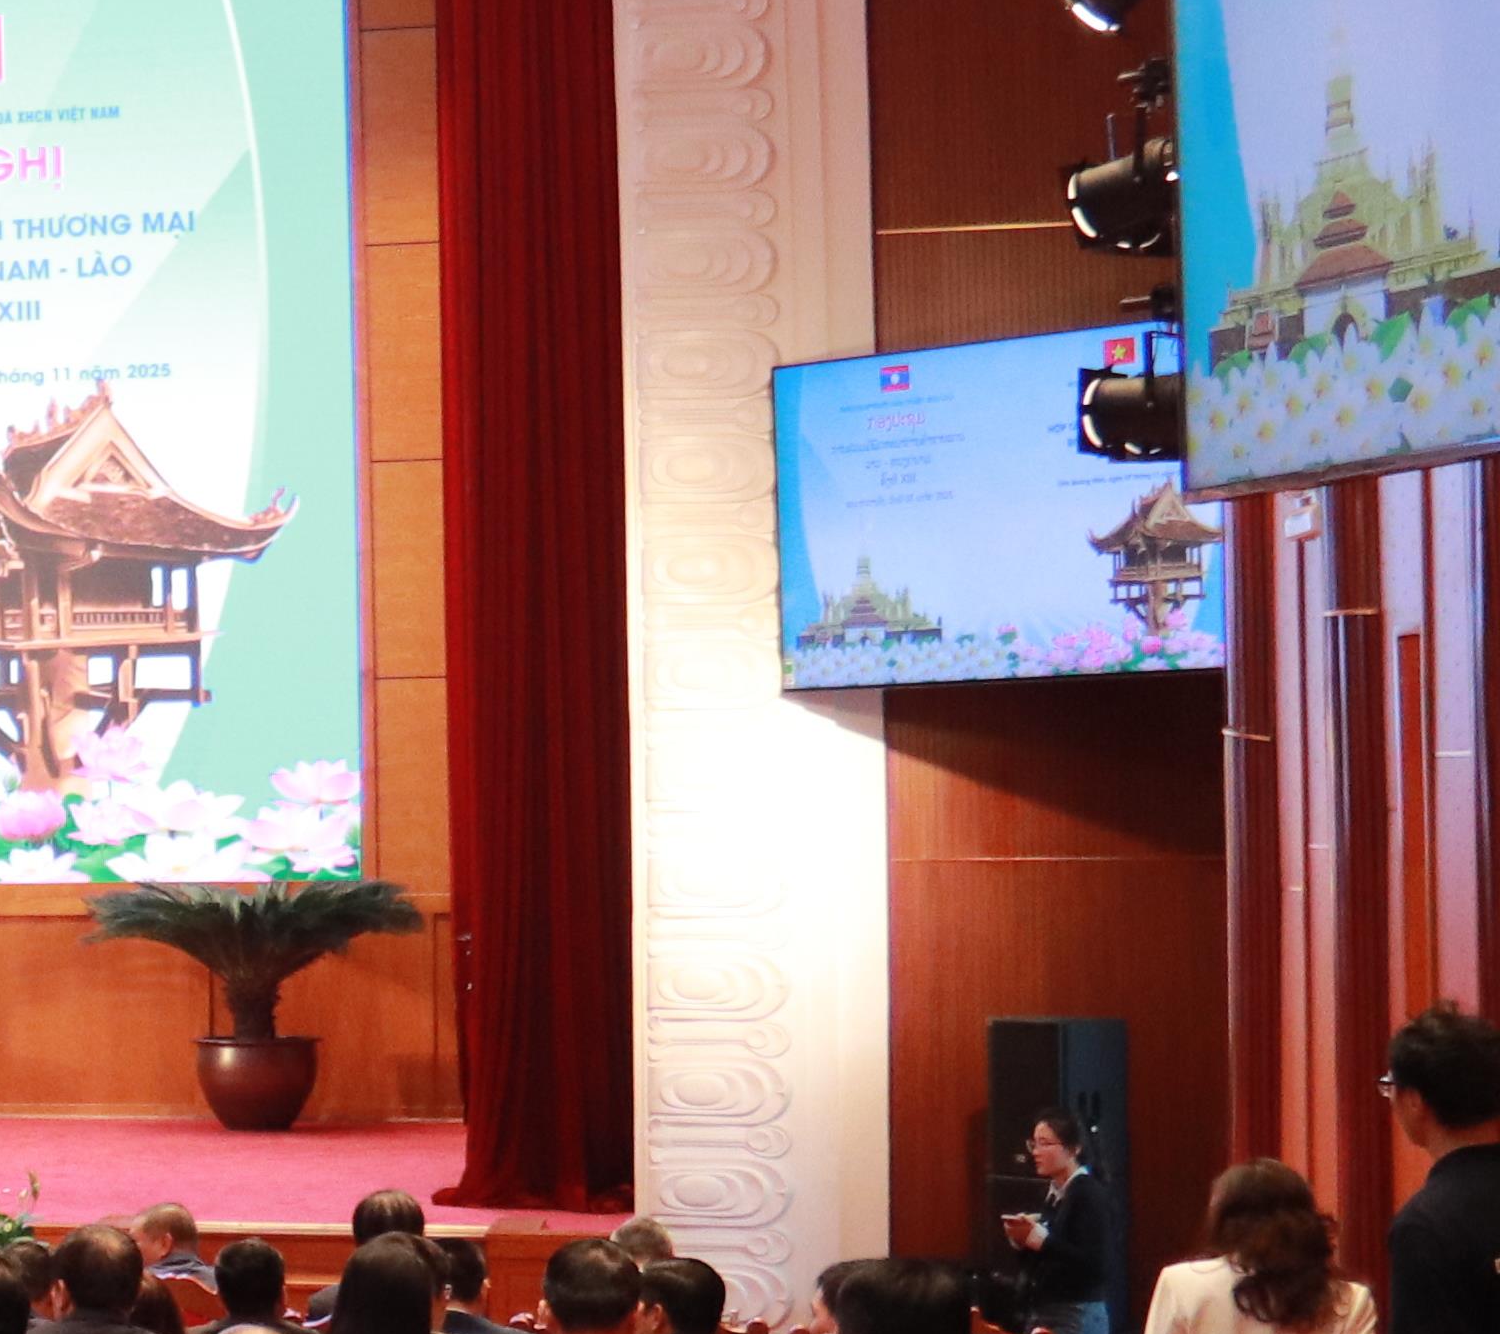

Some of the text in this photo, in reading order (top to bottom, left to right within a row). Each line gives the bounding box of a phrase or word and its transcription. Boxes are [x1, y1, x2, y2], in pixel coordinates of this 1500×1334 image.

[91, 105, 120, 119] NAM
[13, 213, 131, 238] THƯƠNG
[142, 210, 196, 239] MẠI
[77, 250, 132, 277] LÀO
[52, 366, 71, 382] 11
[127, 363, 171, 379] 2025
